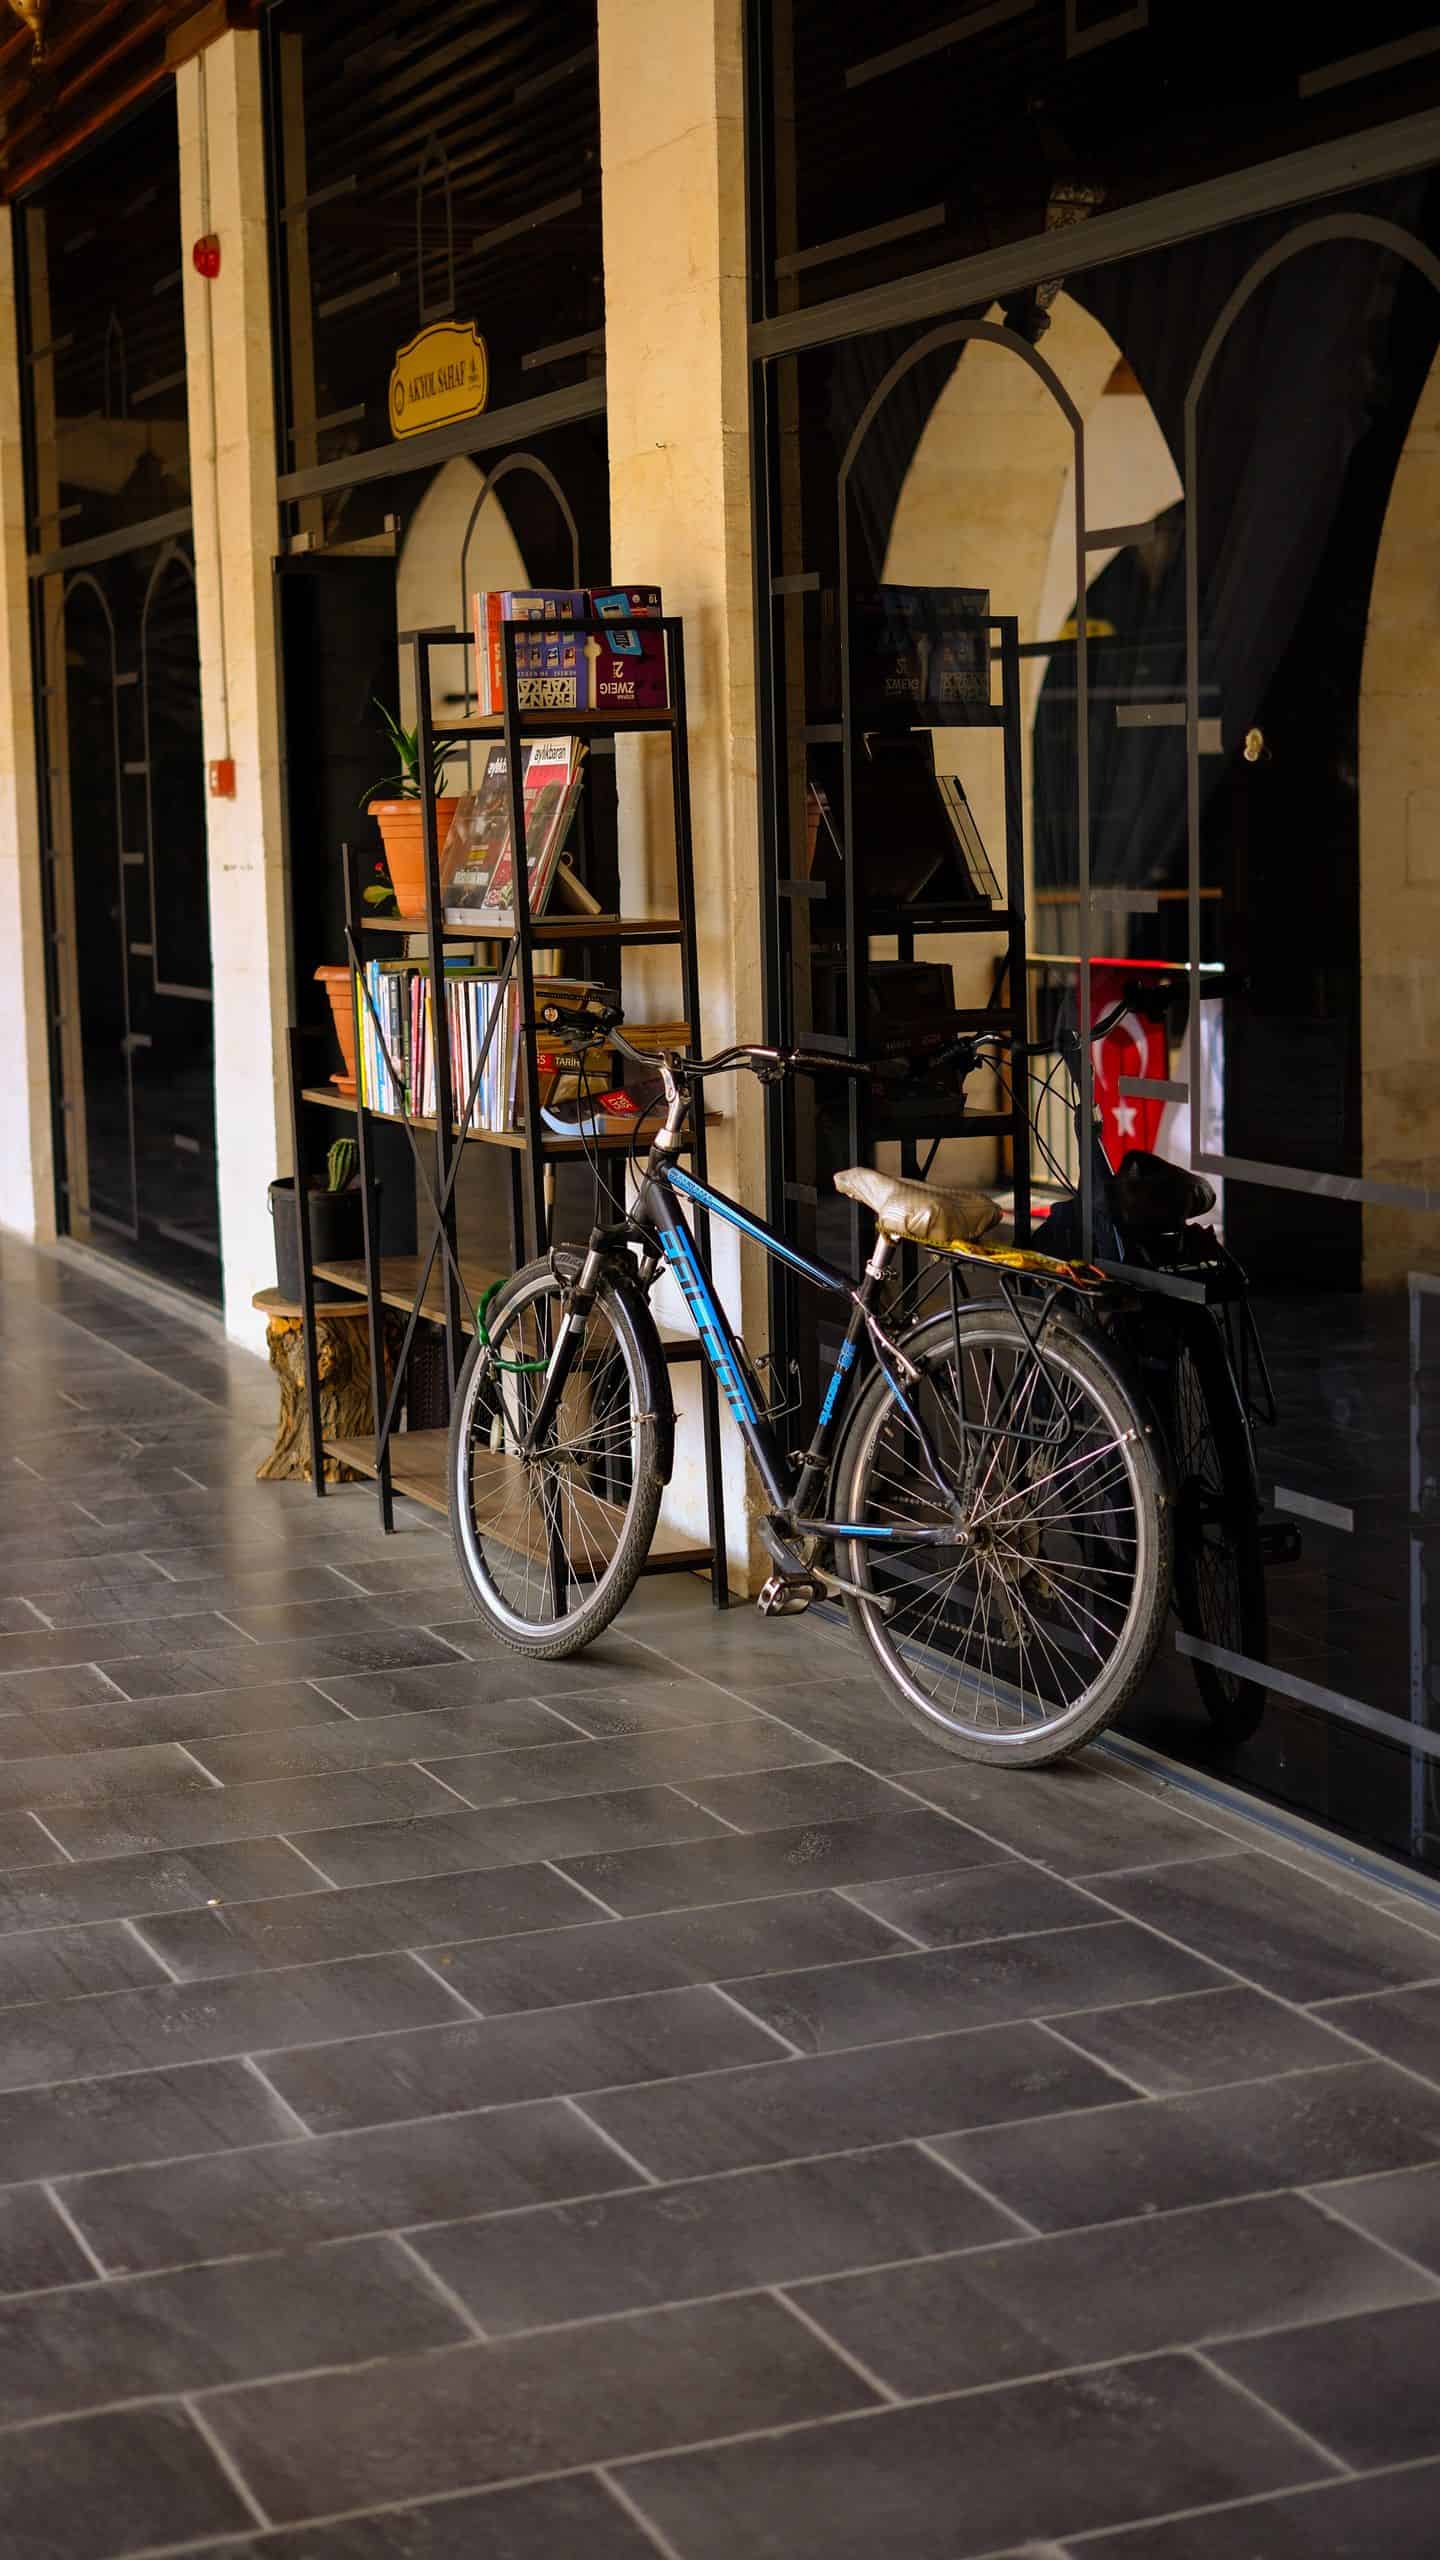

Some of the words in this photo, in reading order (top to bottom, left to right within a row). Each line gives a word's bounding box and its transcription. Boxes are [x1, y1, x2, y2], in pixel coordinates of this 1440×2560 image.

[408, 371, 436, 402] AKYOL
[438, 360, 465, 393] SAHAF
[519, 679, 574, 693] KAFKA
[600, 682, 635, 695] ZWEIG
[519, 693, 574, 707] FRANZ
